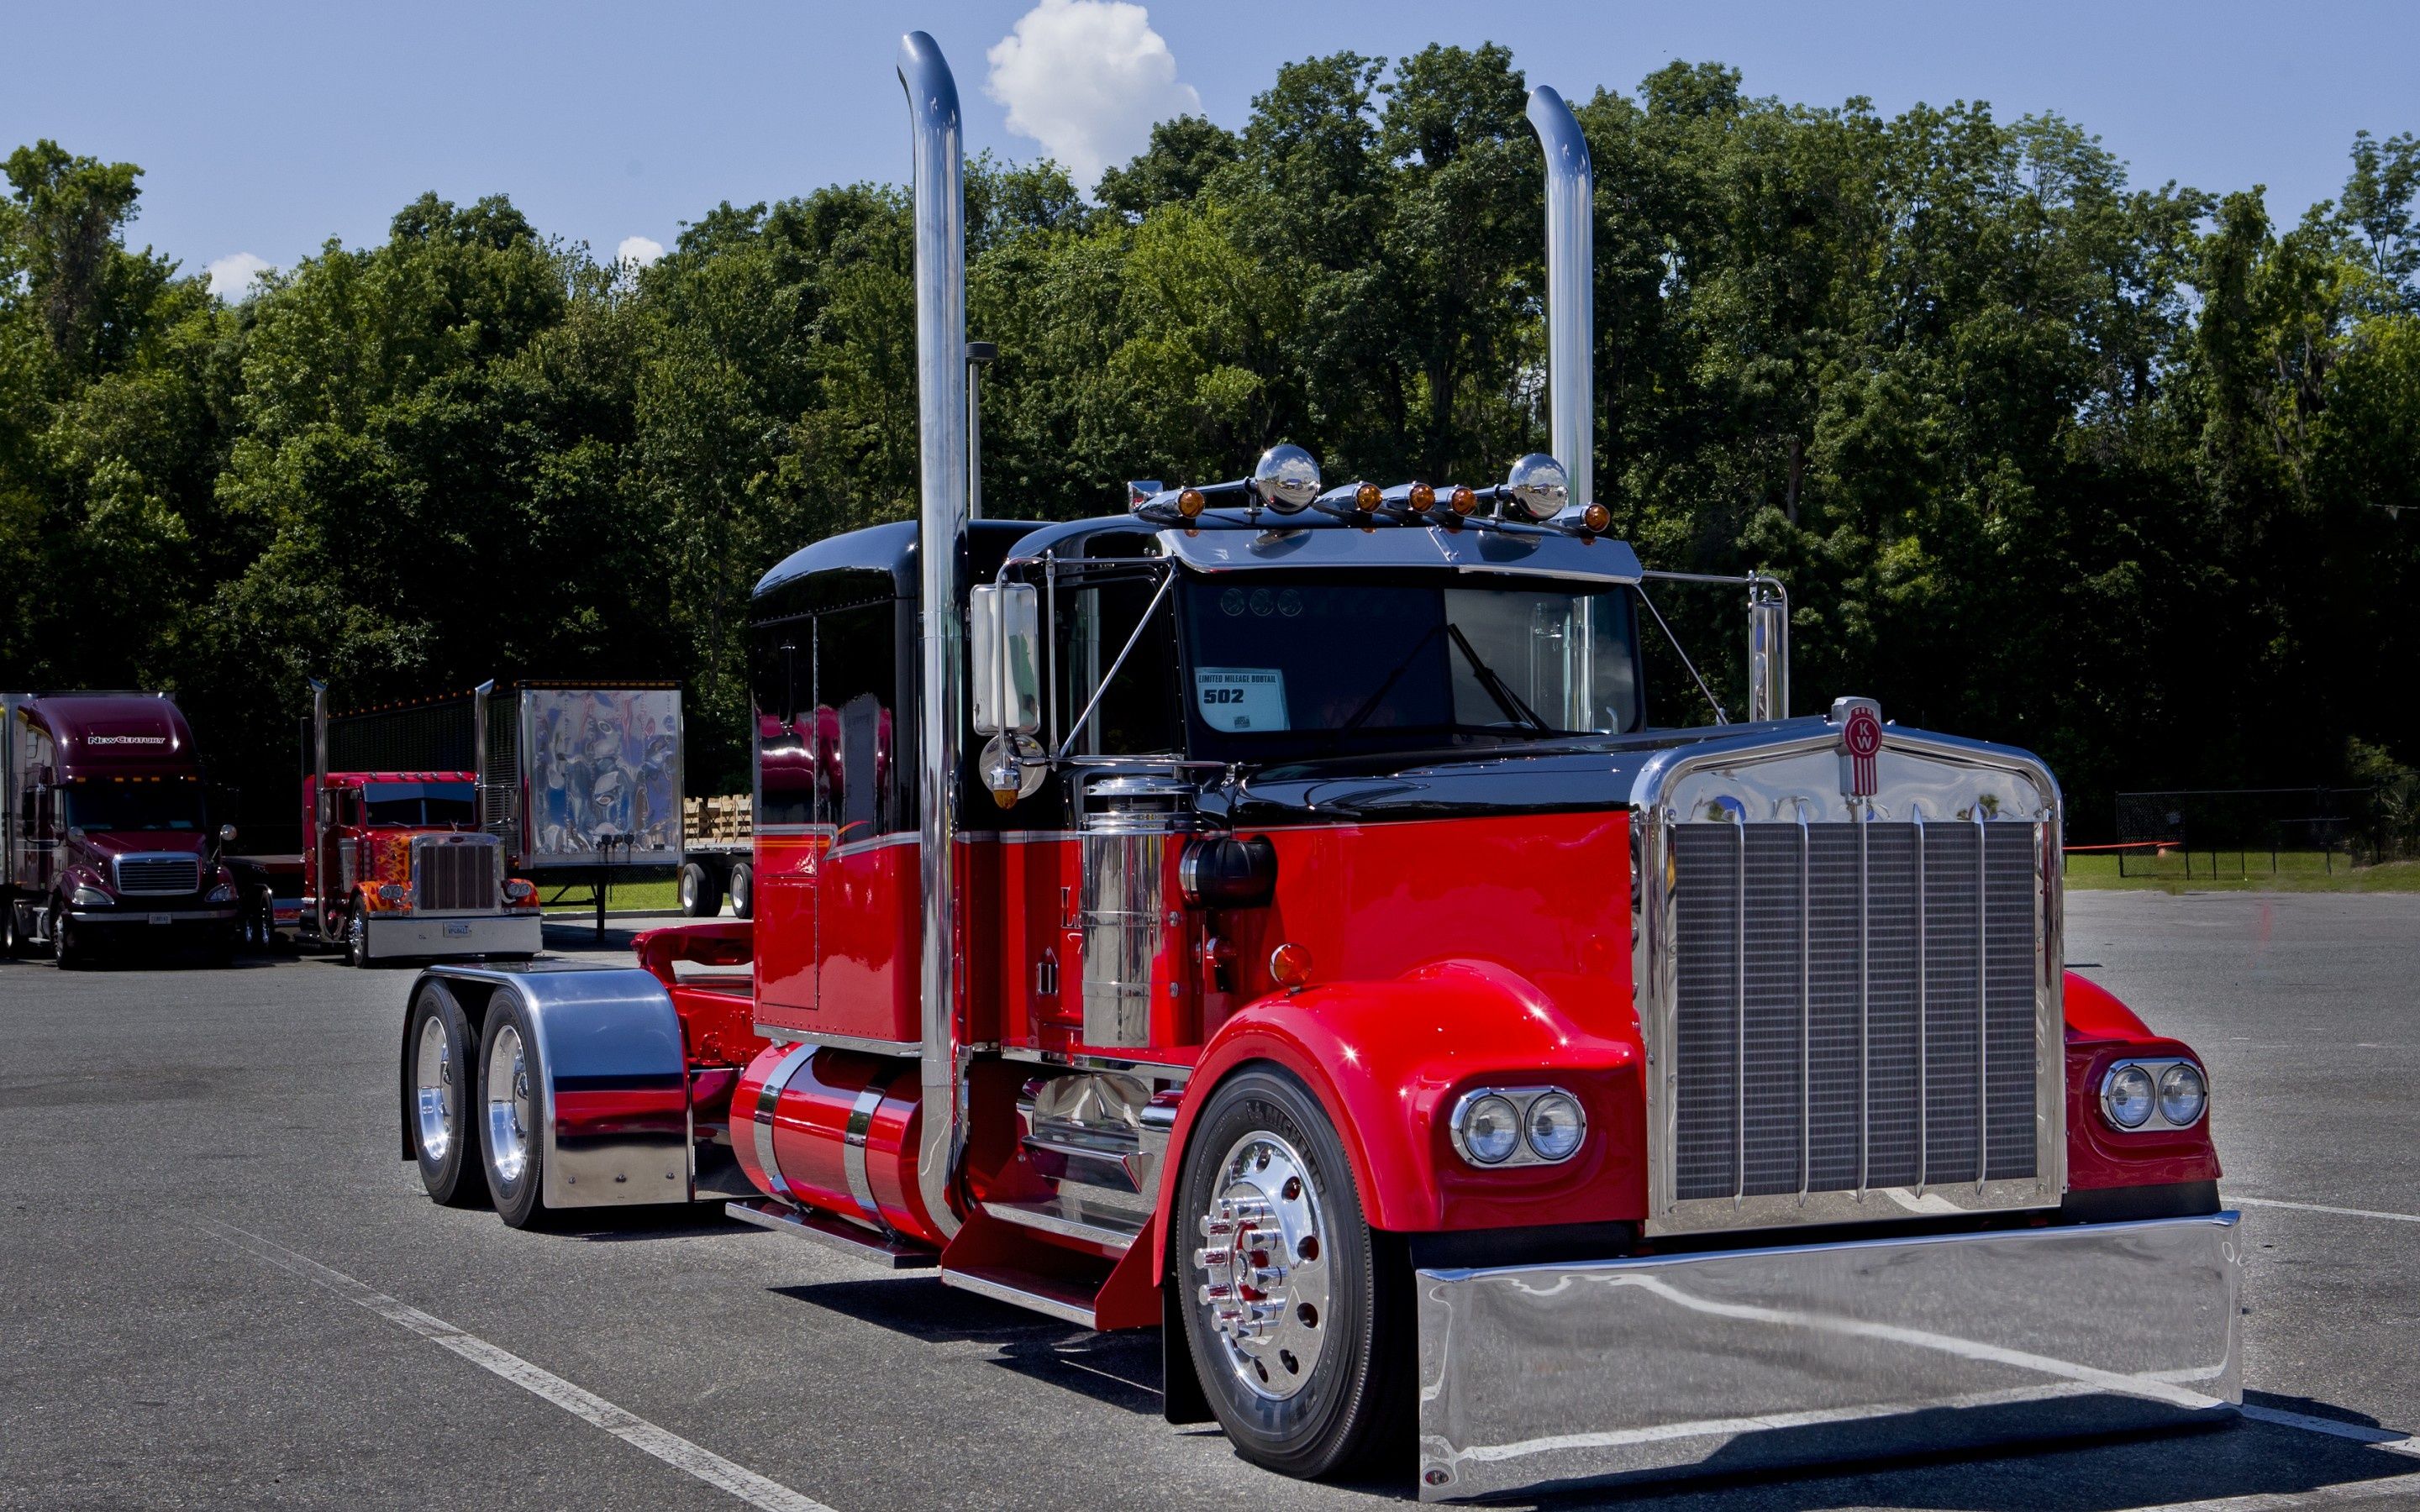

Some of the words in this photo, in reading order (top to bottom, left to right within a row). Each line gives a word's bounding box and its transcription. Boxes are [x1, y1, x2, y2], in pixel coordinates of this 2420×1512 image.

[1198, 675, 1223, 684] LIMITED
[1224, 675, 1250, 684] MILEAGE
[1203, 689, 1244, 704] 502
[1262, 1104, 1326, 1196] MICHELIN
